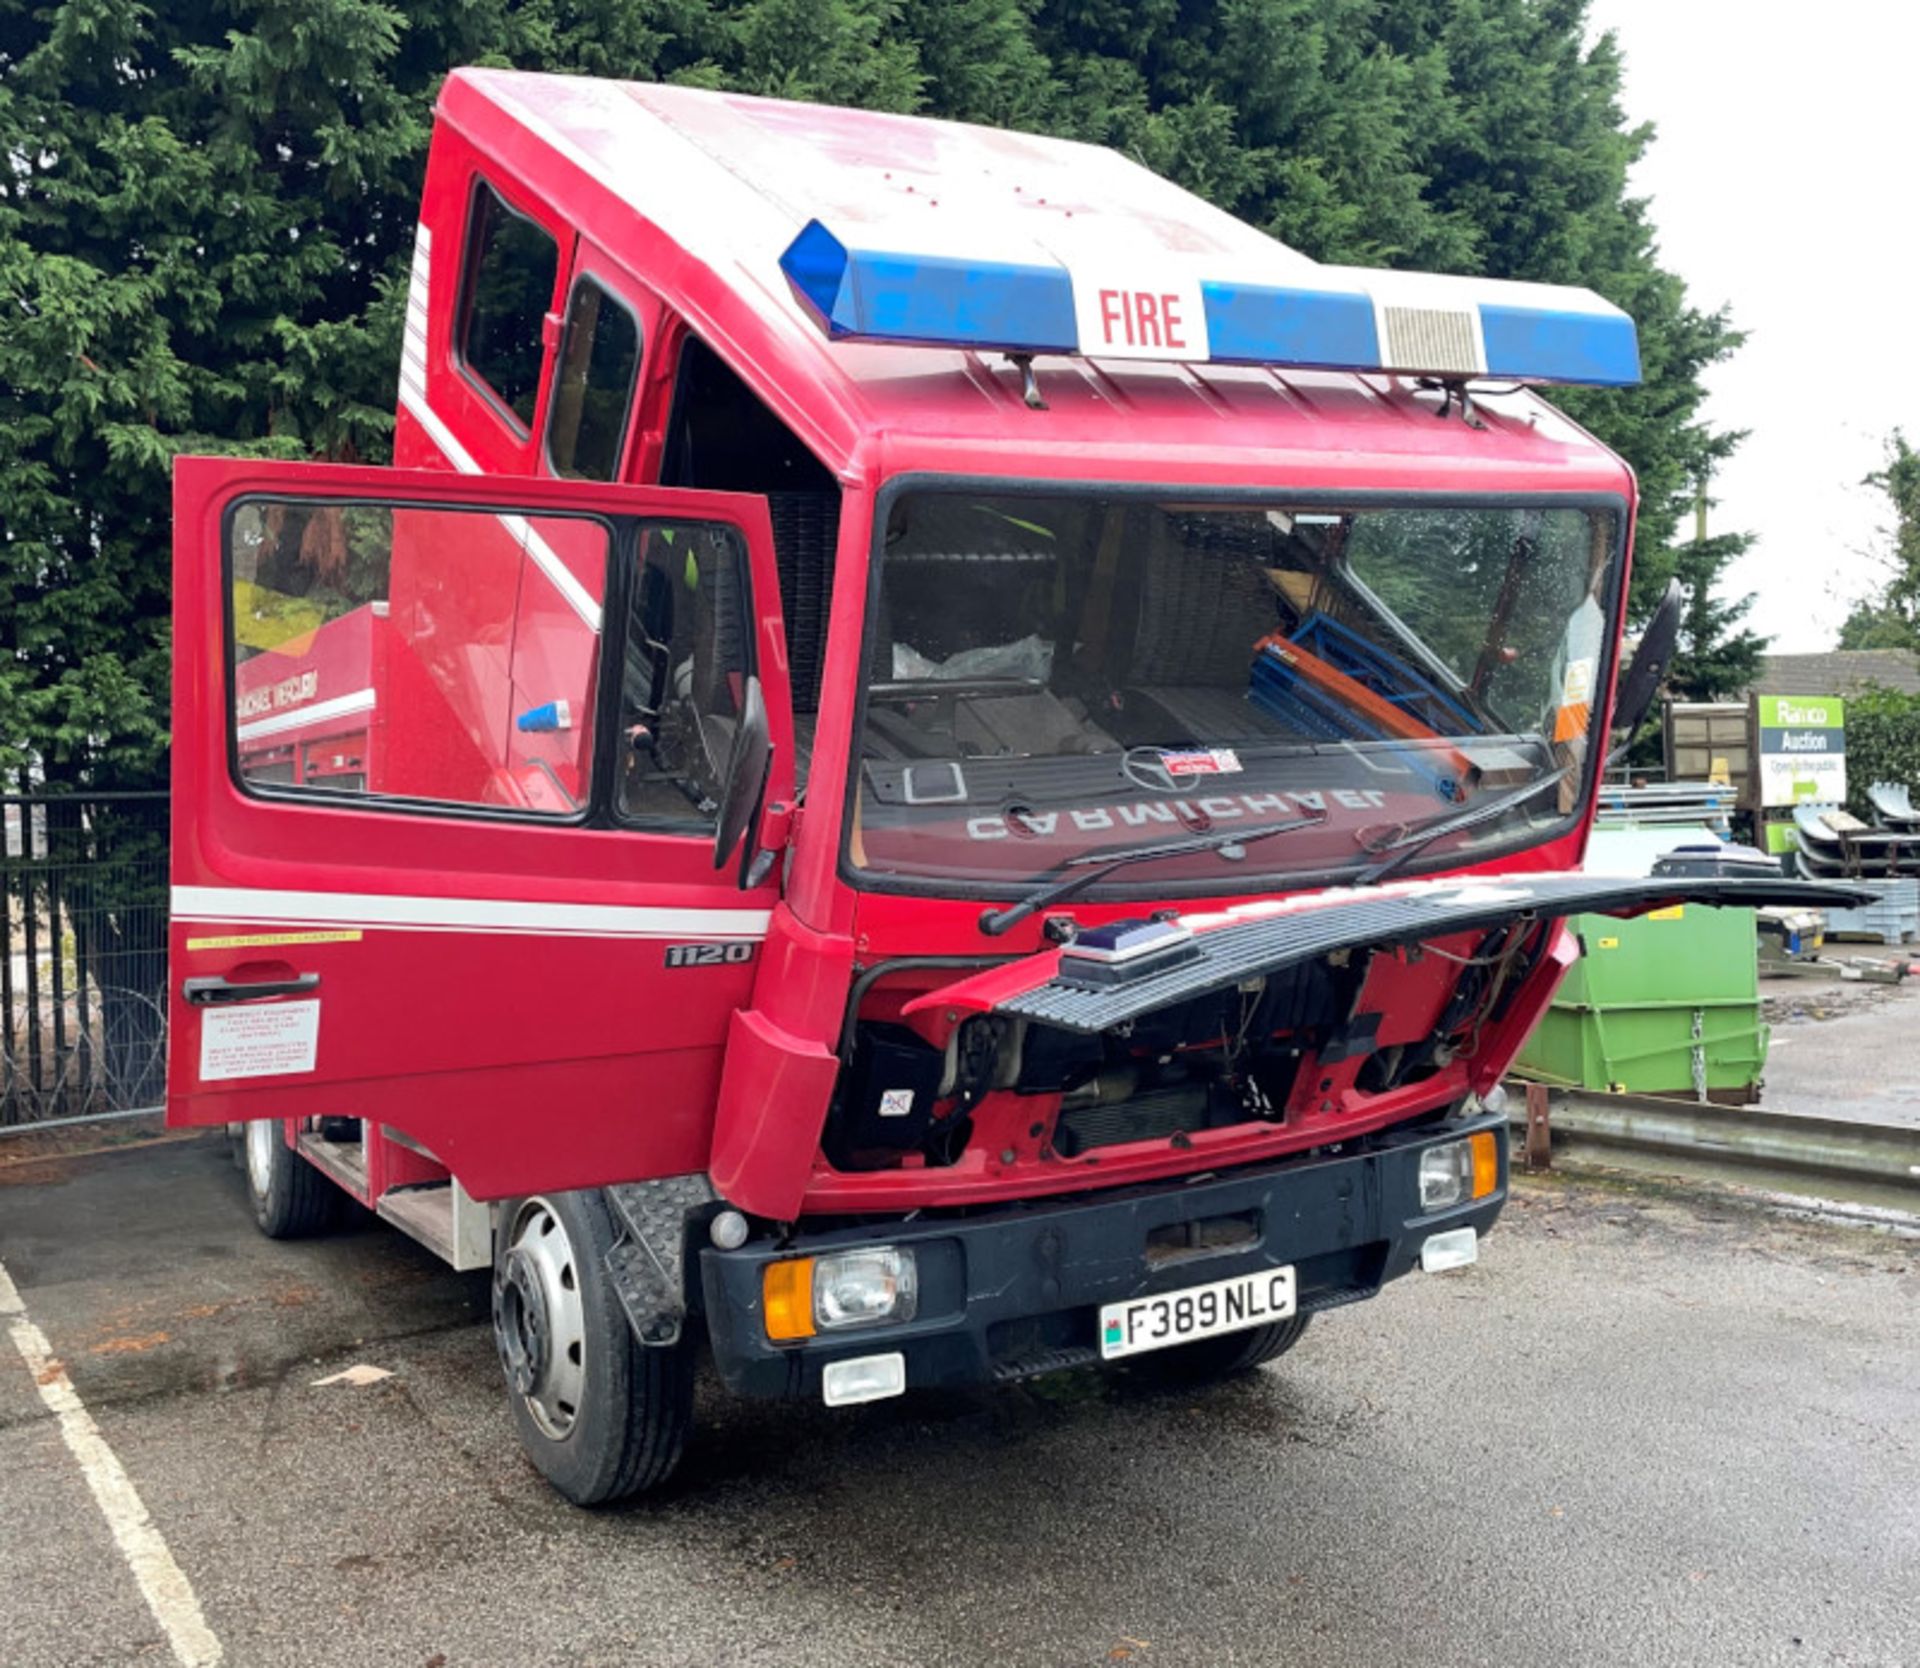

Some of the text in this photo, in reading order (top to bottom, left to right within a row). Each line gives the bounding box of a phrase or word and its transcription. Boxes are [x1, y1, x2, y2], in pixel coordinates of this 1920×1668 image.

[1099, 288, 1186, 348] FIRE
[1777, 700, 1828, 724] Ramco
[1782, 730, 1828, 751] Auction
[670, 943, 753, 967] 1120
[1127, 1275, 1287, 1345] F389 NLC
